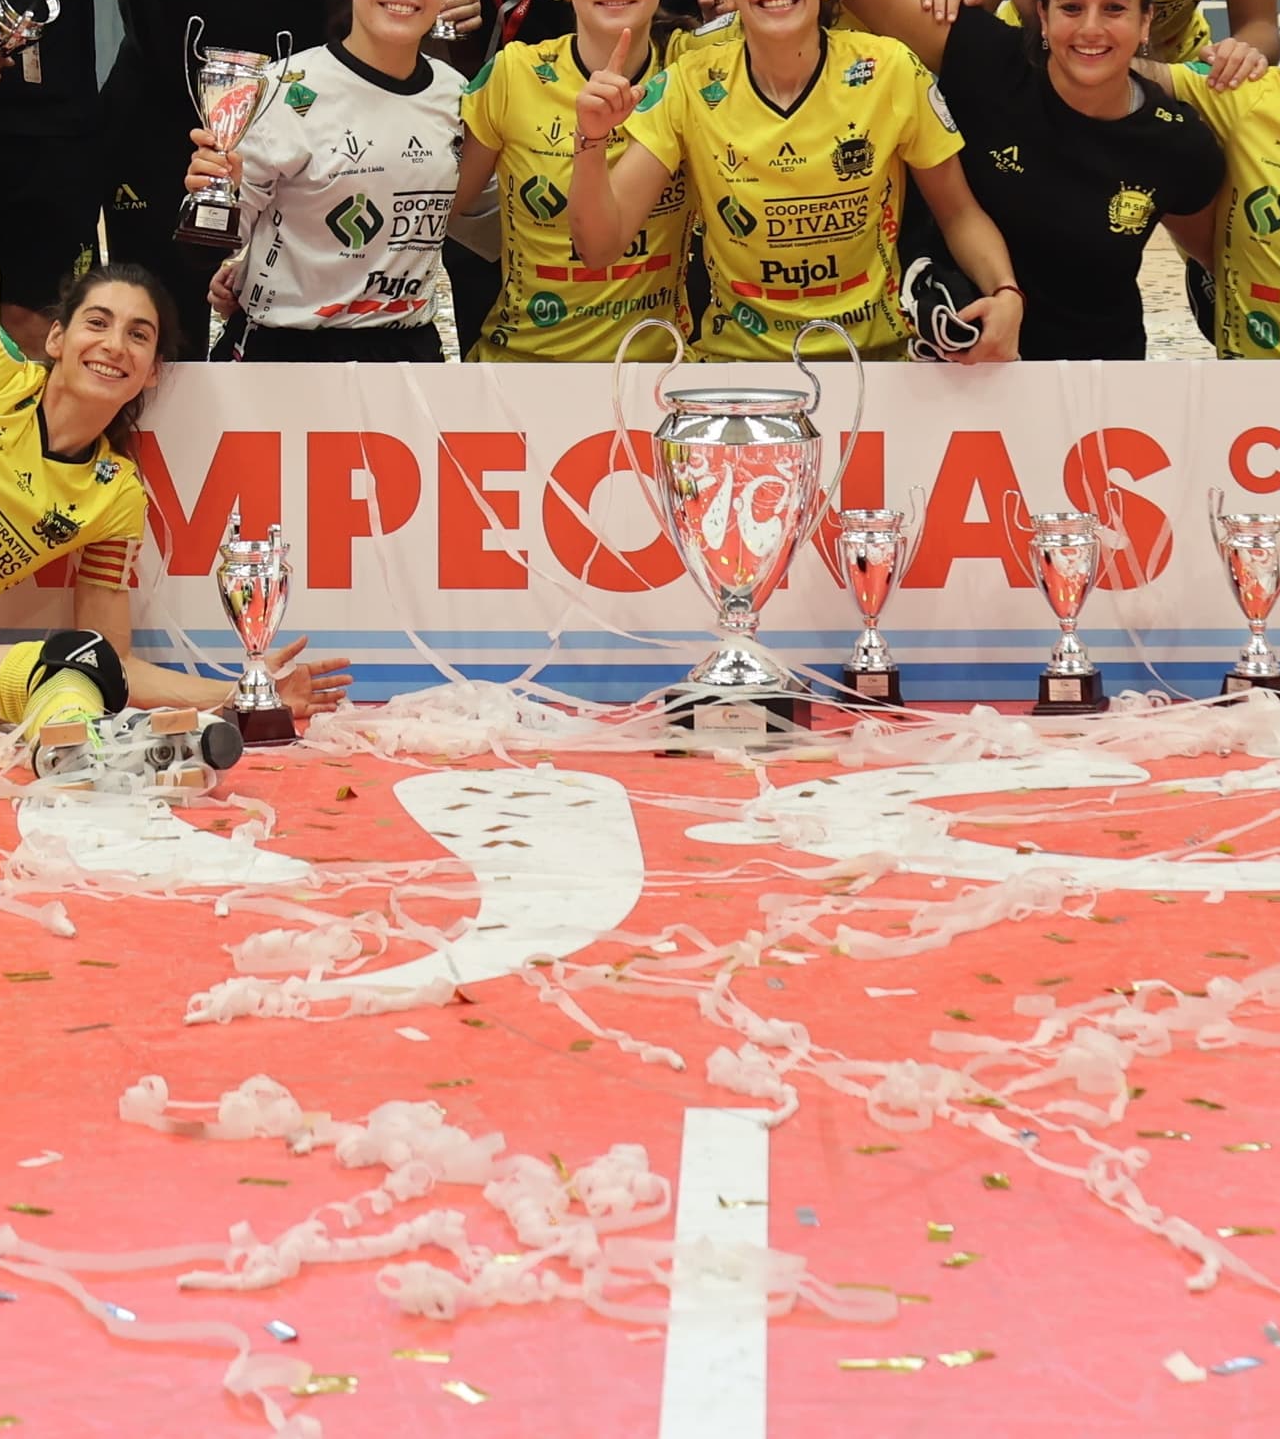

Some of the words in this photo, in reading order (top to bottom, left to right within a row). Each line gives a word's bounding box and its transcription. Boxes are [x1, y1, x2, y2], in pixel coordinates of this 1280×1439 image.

[1155, 107, 1173, 122] DS
[401, 150, 433, 159] ALTAN
[768, 156, 808, 167] ALTAN
[988, 150, 1025, 175] ALTAN
[764, 193, 870, 217] COOPERATIVA
[767, 205, 868, 238] D'IVARS
[760, 254, 840, 290] Pujol
